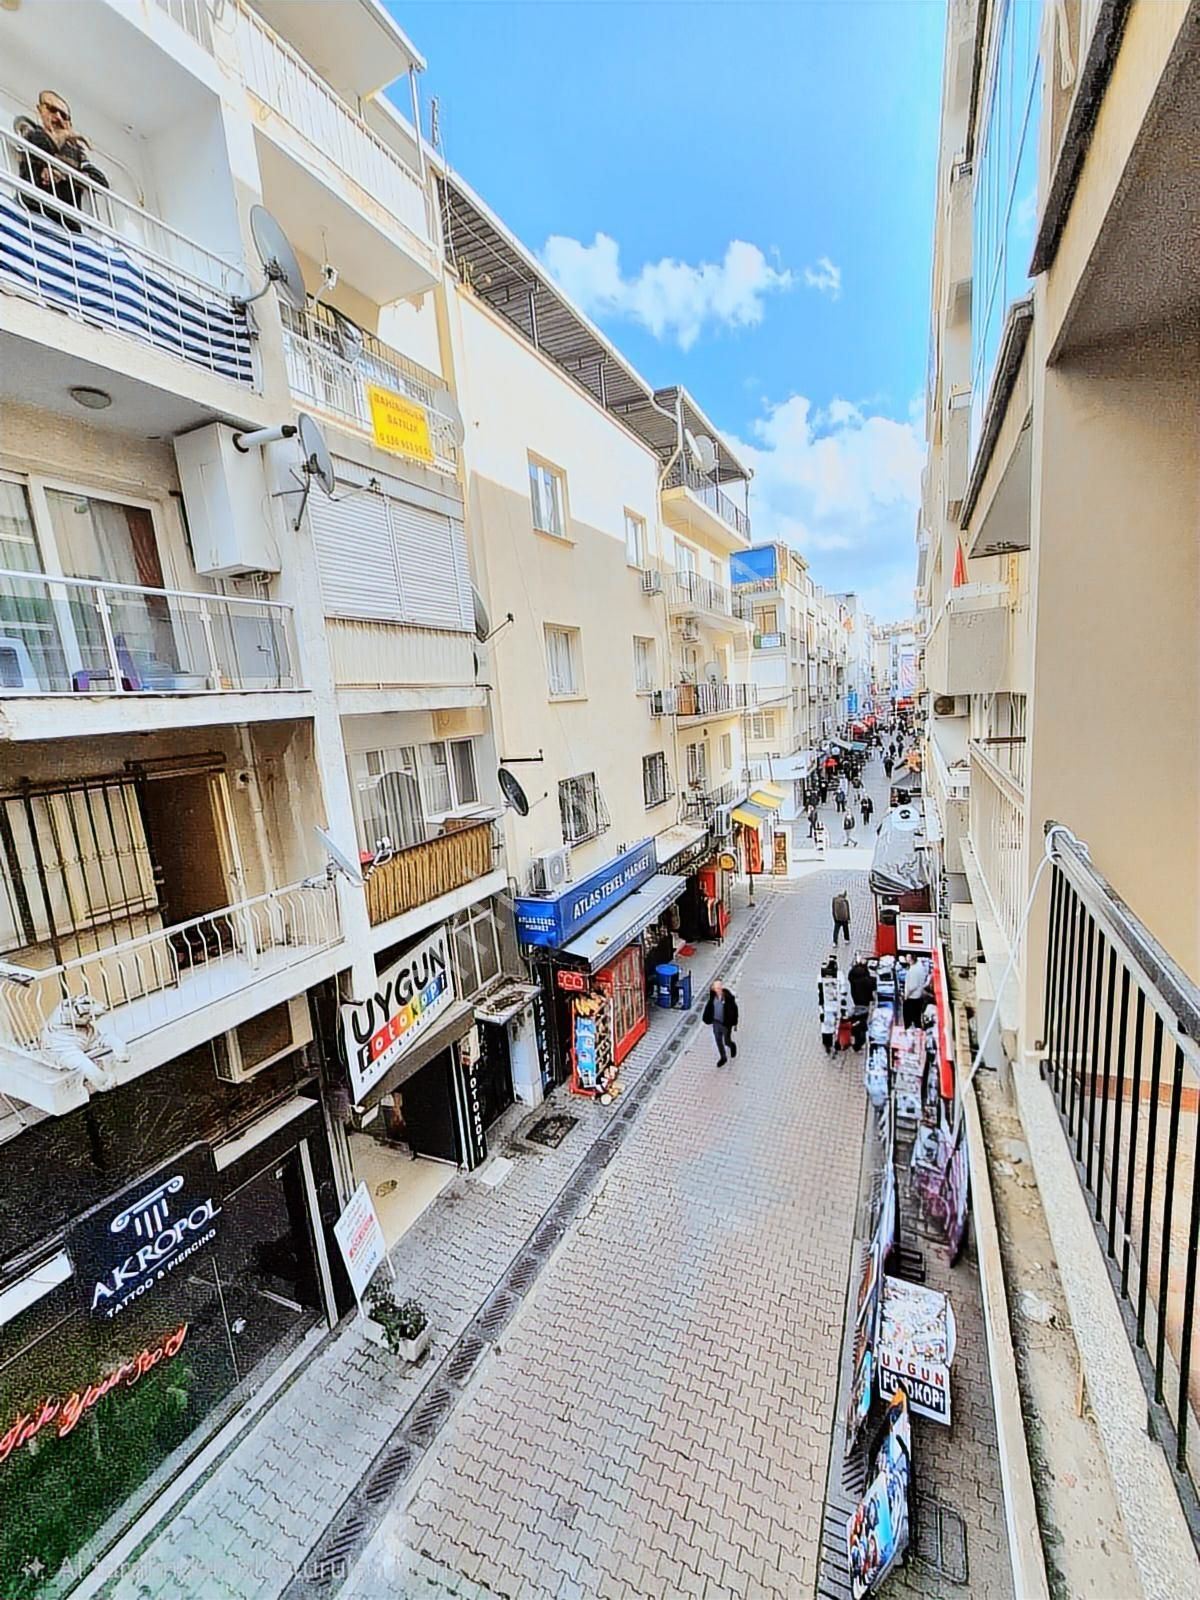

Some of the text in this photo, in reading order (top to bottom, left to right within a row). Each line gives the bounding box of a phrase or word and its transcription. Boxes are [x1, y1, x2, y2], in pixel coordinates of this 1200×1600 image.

[573, 889, 601, 920] ATLAS
[601, 873, 624, 898] TEKEL
[624, 855, 650, 882] MARKET
[907, 925, 924, 944] E
[351, 938, 446, 1045] UYGUN
[536, 974, 546, 1026] ALAS
[90, 1198, 222, 1310] AKROPOL
[106, 1278, 154, 1317] TATTOO
[167, 1228, 216, 1270] PIERCING
[882, 1353, 944, 1387] UYGUN
